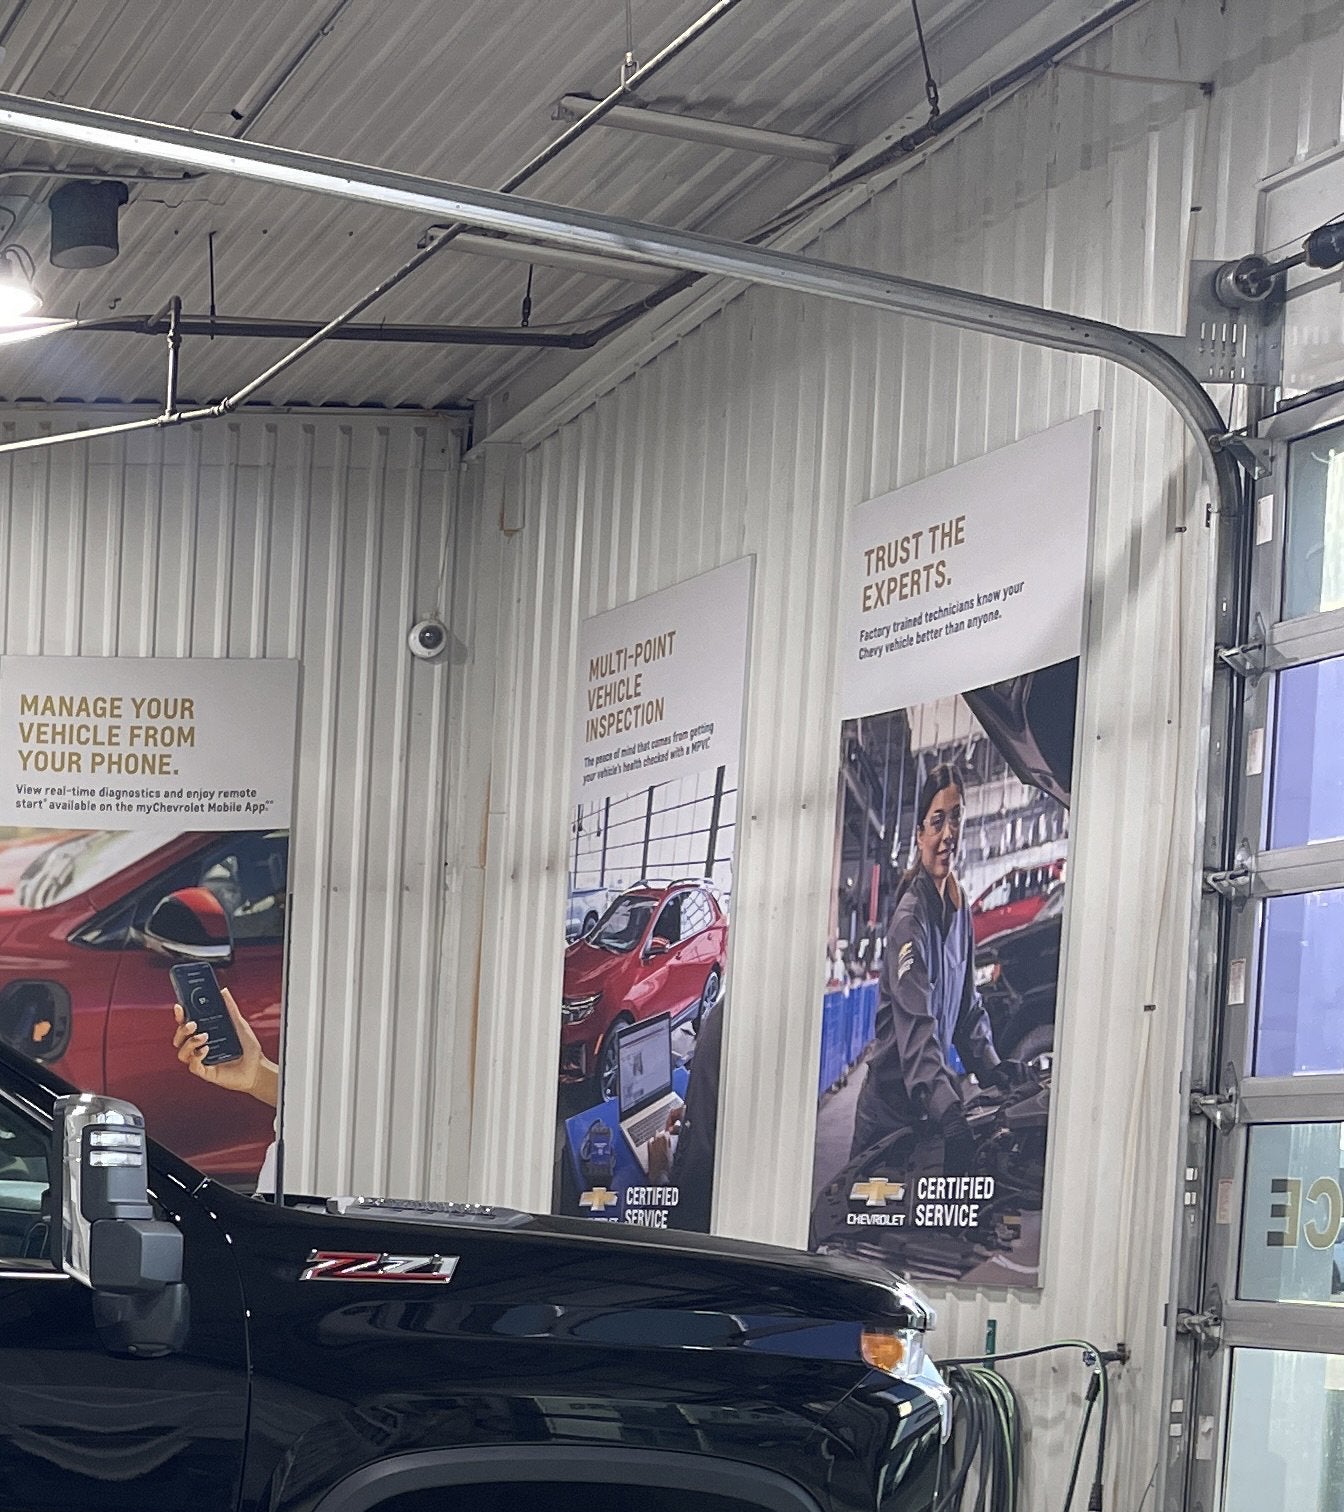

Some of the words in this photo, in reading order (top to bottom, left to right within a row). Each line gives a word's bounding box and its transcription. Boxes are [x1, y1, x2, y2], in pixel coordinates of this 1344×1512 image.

[864, 531, 923, 577] TRUST
[928, 515, 966, 554] THE
[862, 559, 952, 613] EXPERTS.
[859, 624, 890, 642] Factory
[892, 612, 923, 632] trained
[924, 598, 974, 623] technicians
[976, 589, 1001, 606] know
[1003, 581, 1025, 601] your
[858, 642, 883, 660] Chevy
[885, 633, 913, 653] vehicle
[915, 626, 943, 645] better
[945, 619, 965, 636] than
[967, 609, 1002, 629] anyone.
[589, 630, 676, 682] MULTI-POINT
[588, 673, 642, 711] VEHICLE
[20, 694, 123, 718] MANAGE
[130, 697, 195, 719] YOUR
[586, 697, 664, 742] INSPECTION
[19, 722, 121, 746] VEHICLE
[129, 725, 196, 747] FROM
[17, 750, 82, 773] YOUR
[90, 753, 179, 775] PHONE.
[16, 784, 42, 795] View
[45, 784, 96, 797] real-time
[99, 786, 160, 799] diagnostics
[163, 787, 184, 798] and
[186, 788, 215, 801] enjoy
[217, 788, 257, 798] remote
[48, 800, 97, 811] available
[99, 803, 112, 811] on
[115, 801, 133, 812] the
[208, 801, 242, 812] Mobile
[626, 1187, 679, 1206] CERTIFIED
[917, 1176, 995, 1200] CERTIFIED
[625, 1209, 668, 1229] SERVICE
[847, 1213, 906, 1226] CHEVROLET
[915, 1204, 979, 1227] SERVICE
[300, 1249, 460, 1283] Z71
